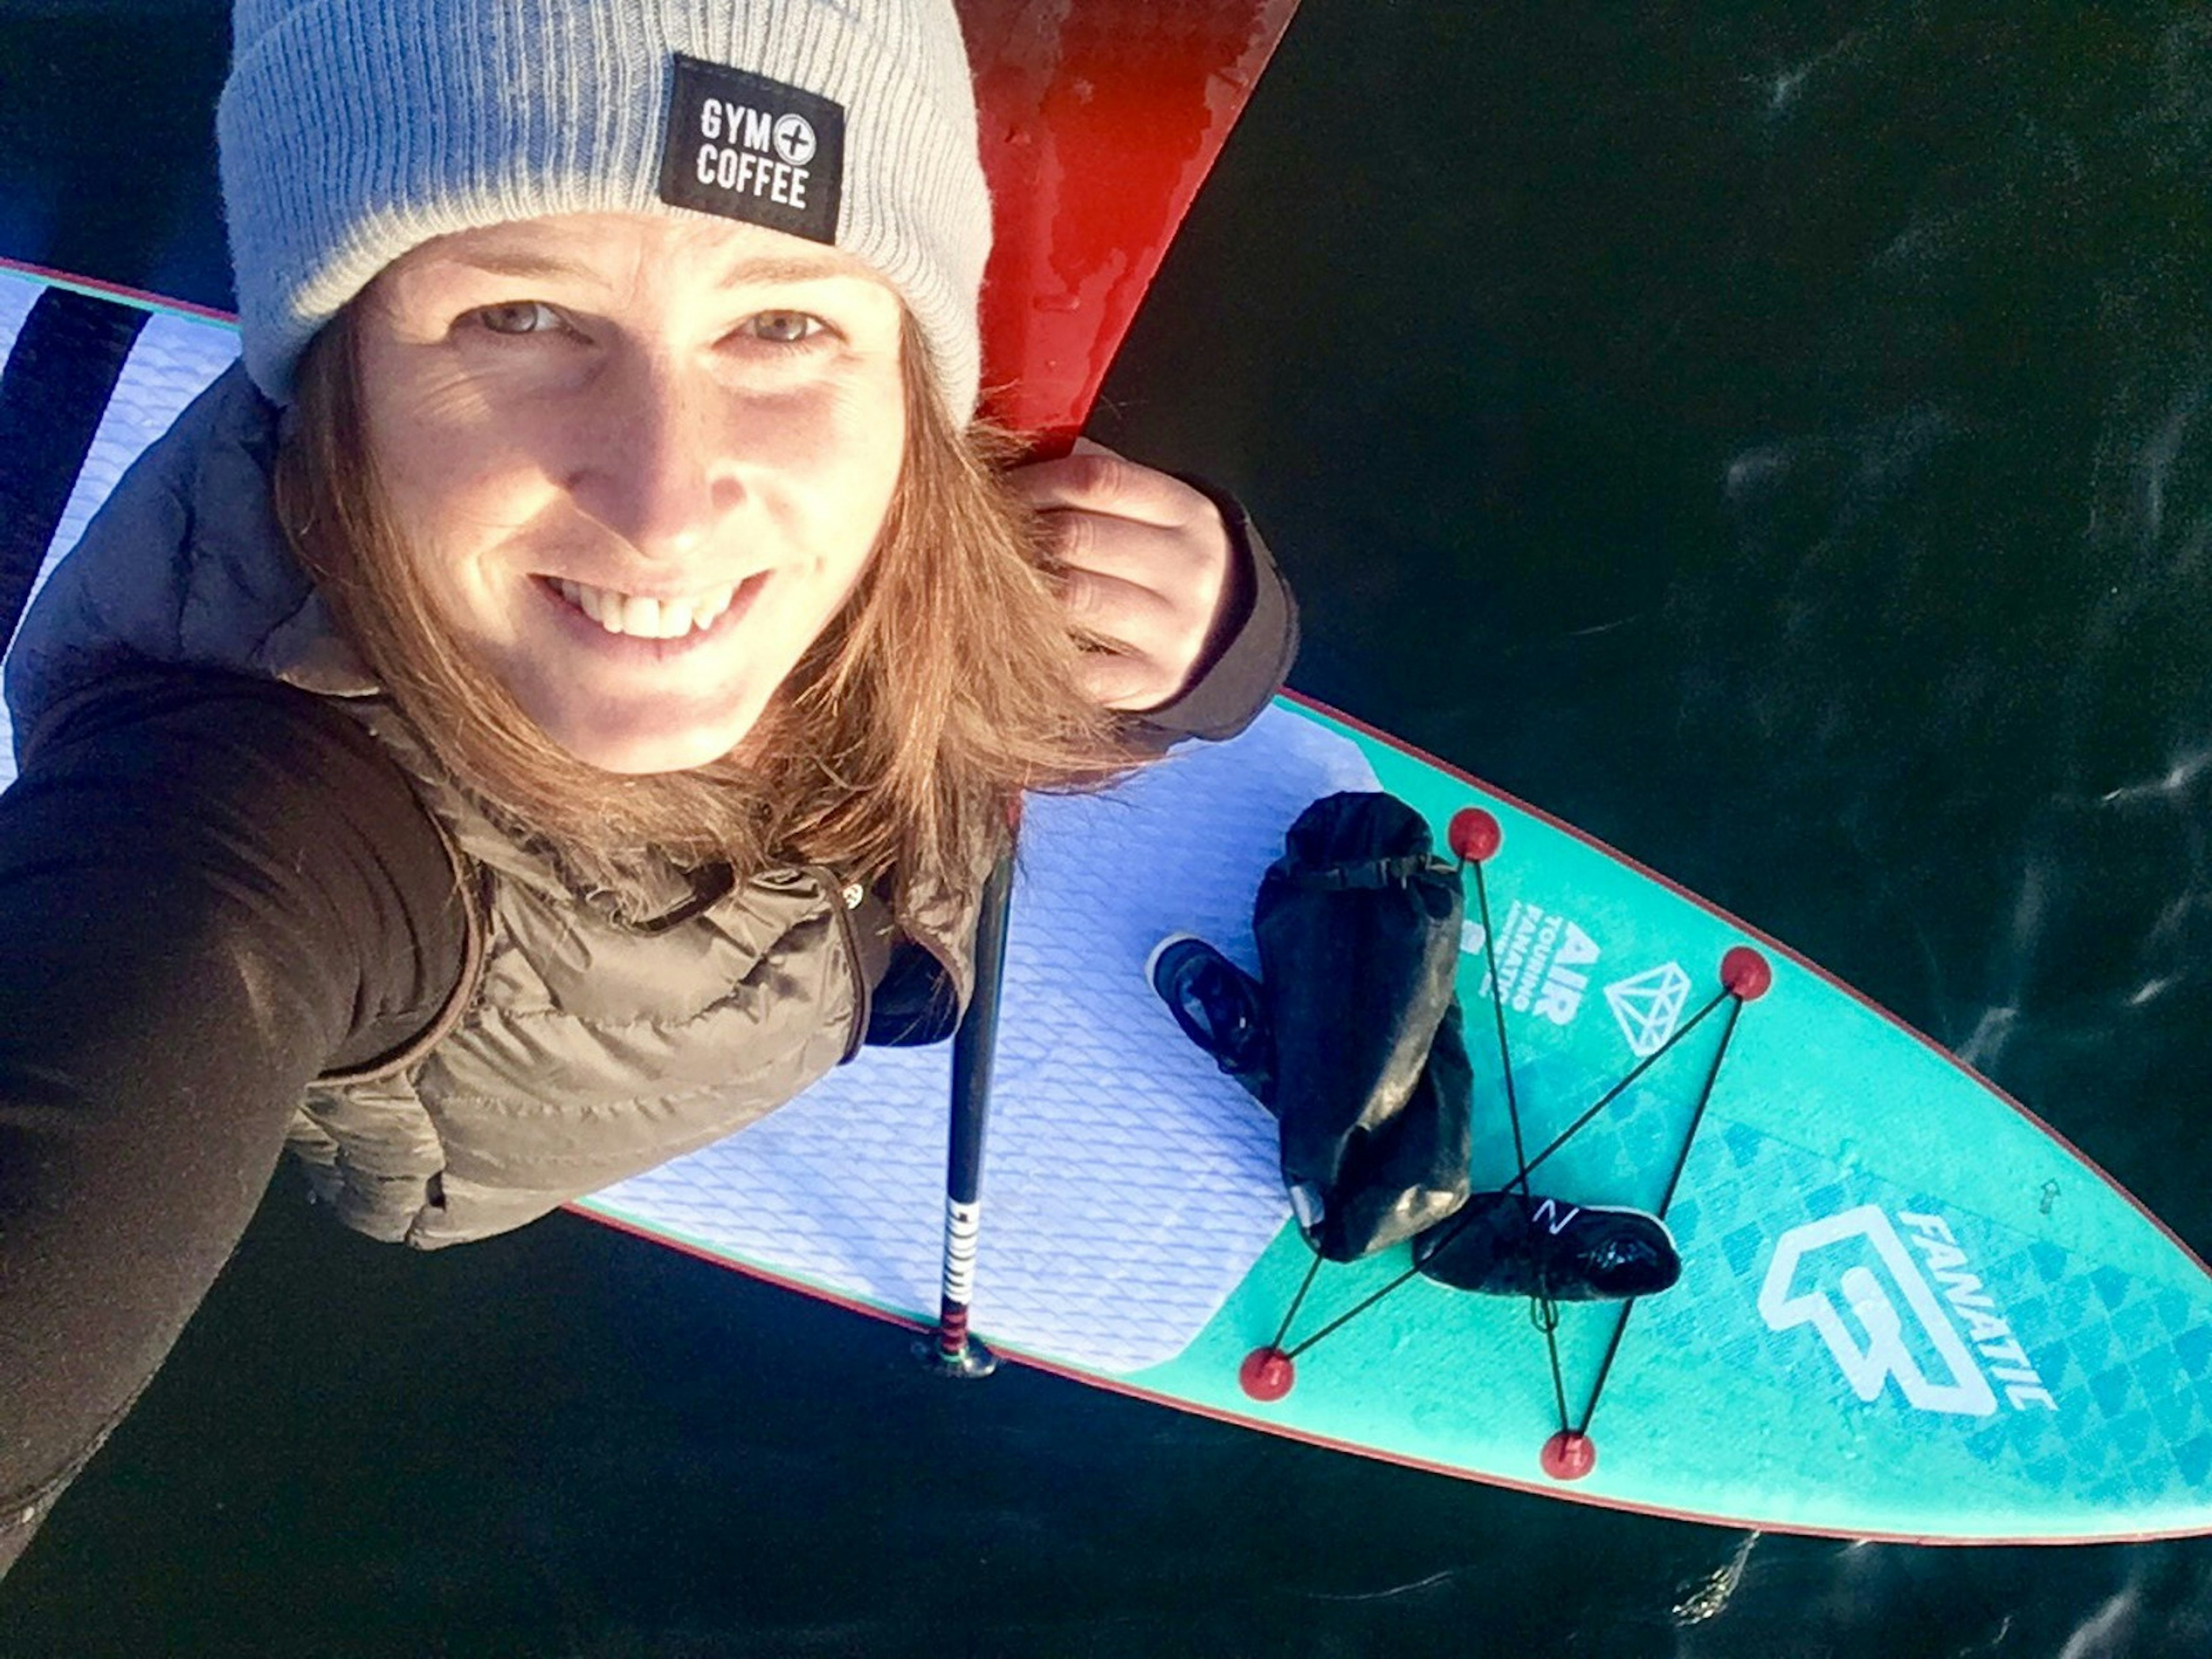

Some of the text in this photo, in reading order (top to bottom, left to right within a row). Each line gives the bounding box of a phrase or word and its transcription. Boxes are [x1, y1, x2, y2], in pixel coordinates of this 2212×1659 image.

[701, 97, 772, 153] GYM
[696, 143, 810, 210] COFFEE
[1532, 921, 1601, 1026] AIR
[1898, 1211, 2059, 1411] FANATIC
